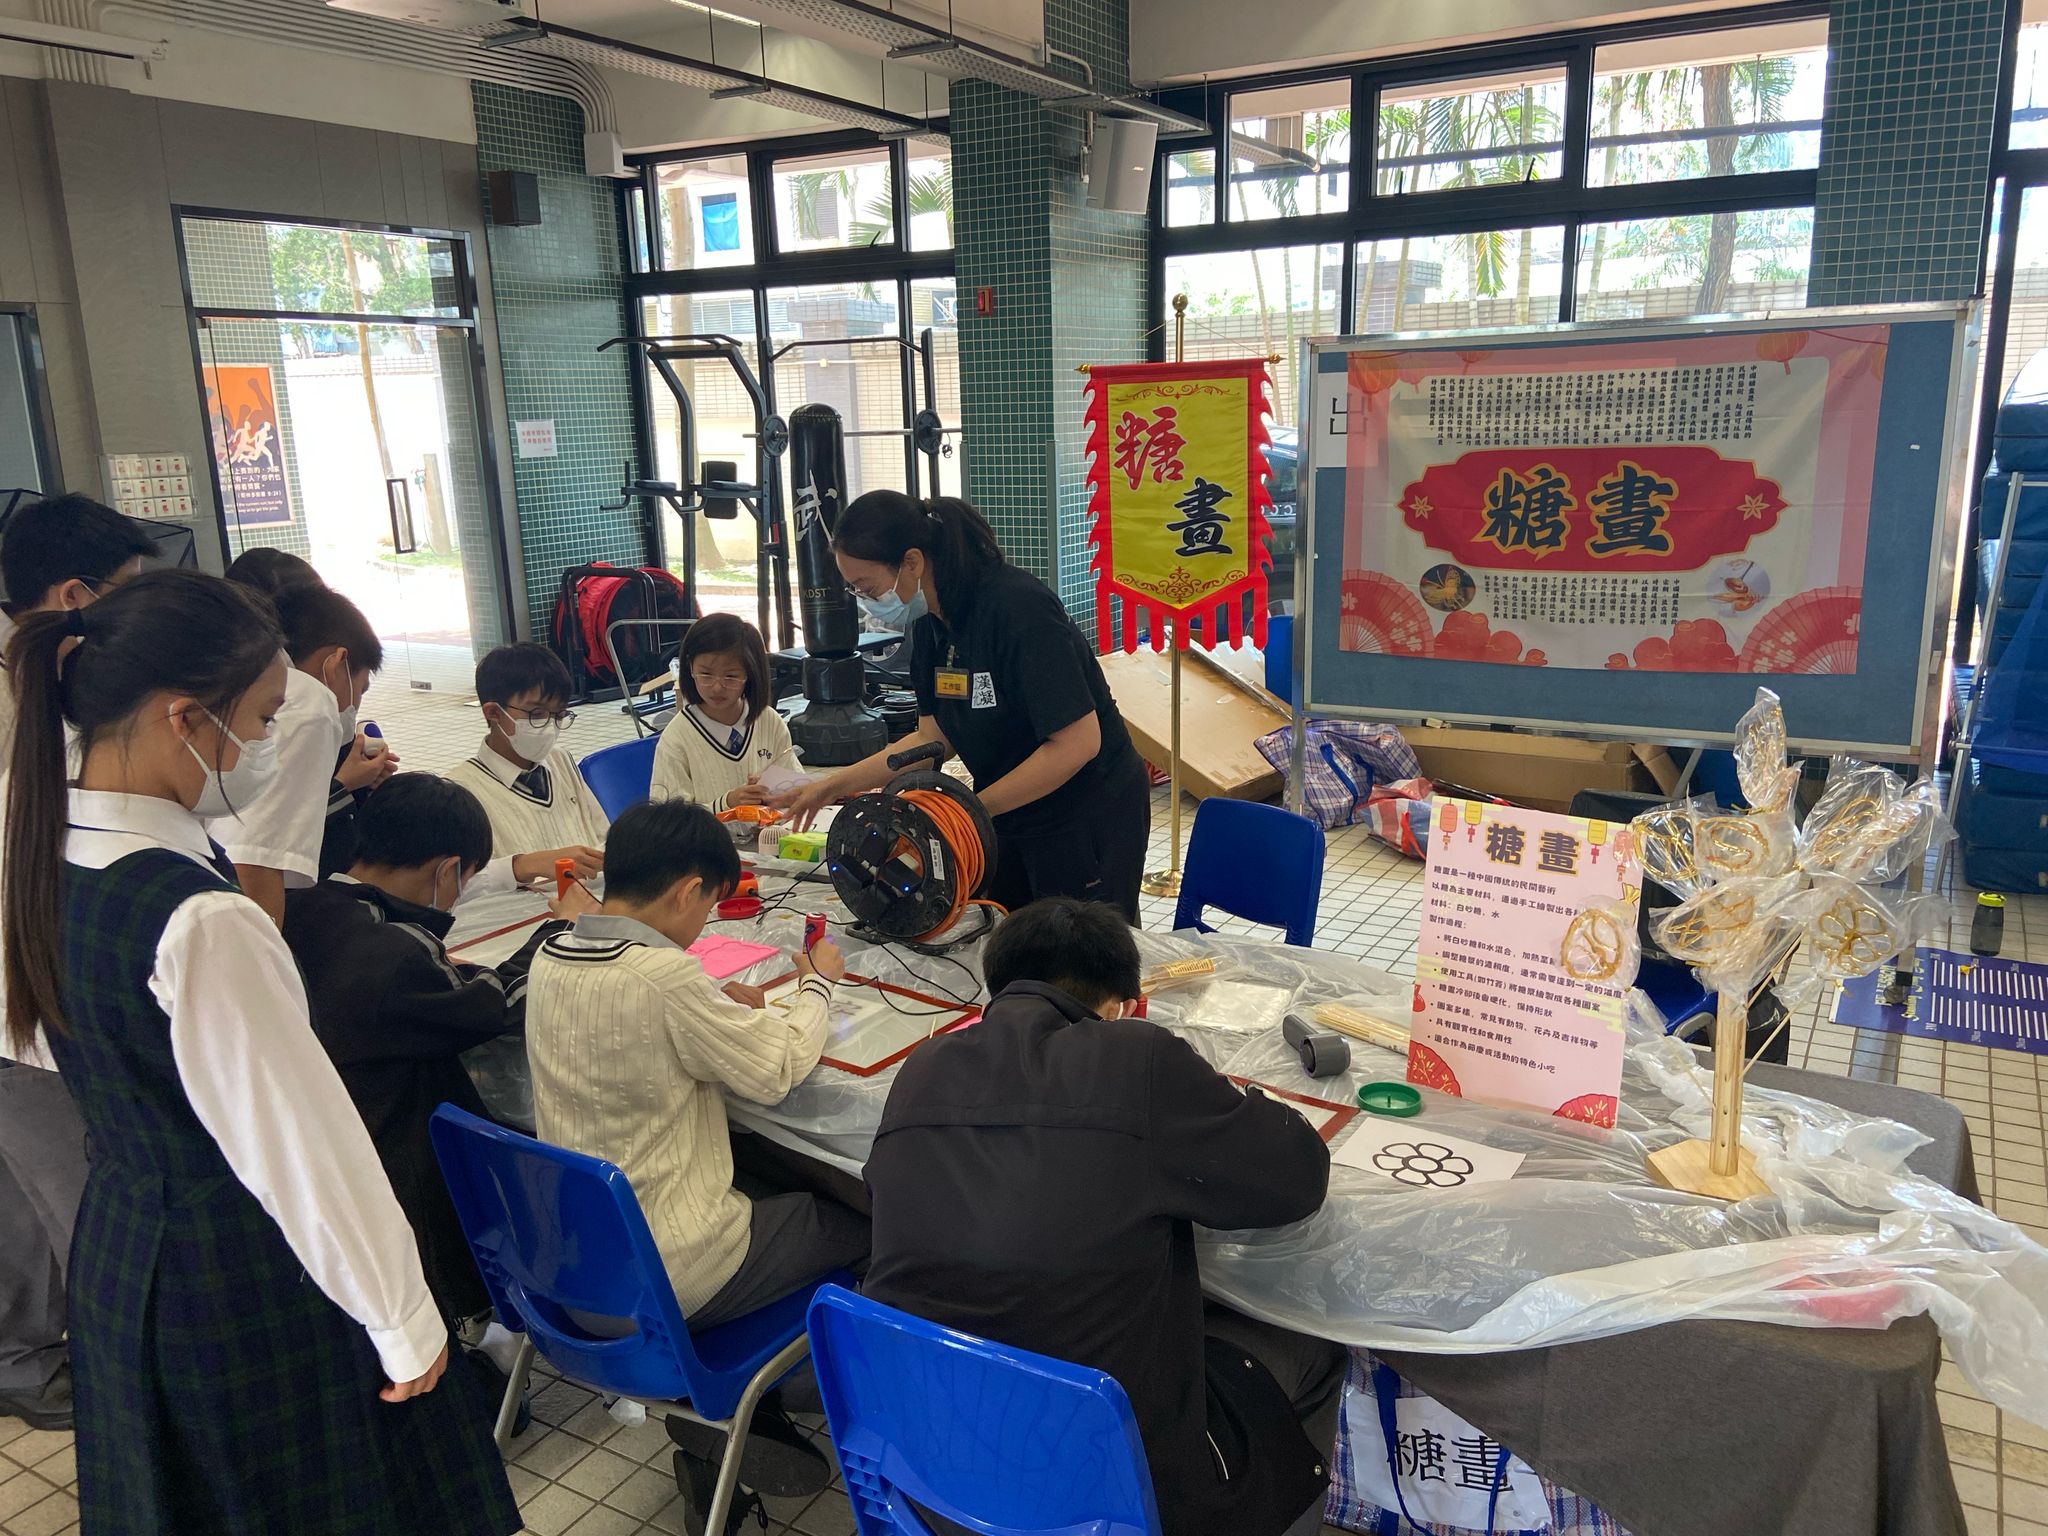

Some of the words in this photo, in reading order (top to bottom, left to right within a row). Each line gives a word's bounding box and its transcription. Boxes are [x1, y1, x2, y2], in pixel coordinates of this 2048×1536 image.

[1115, 406, 1233, 557] 糖畫
[1474, 461, 1680, 560] 糖畫
[1434, 865, 1556, 895] 糖畫是一種中國傳統的民間藝術
[1485, 822, 1580, 877] 糖畫
[1436, 1018, 1512, 1045] 具有觀賞性和食用性
[1387, 1426, 1516, 1493] 糖畫
